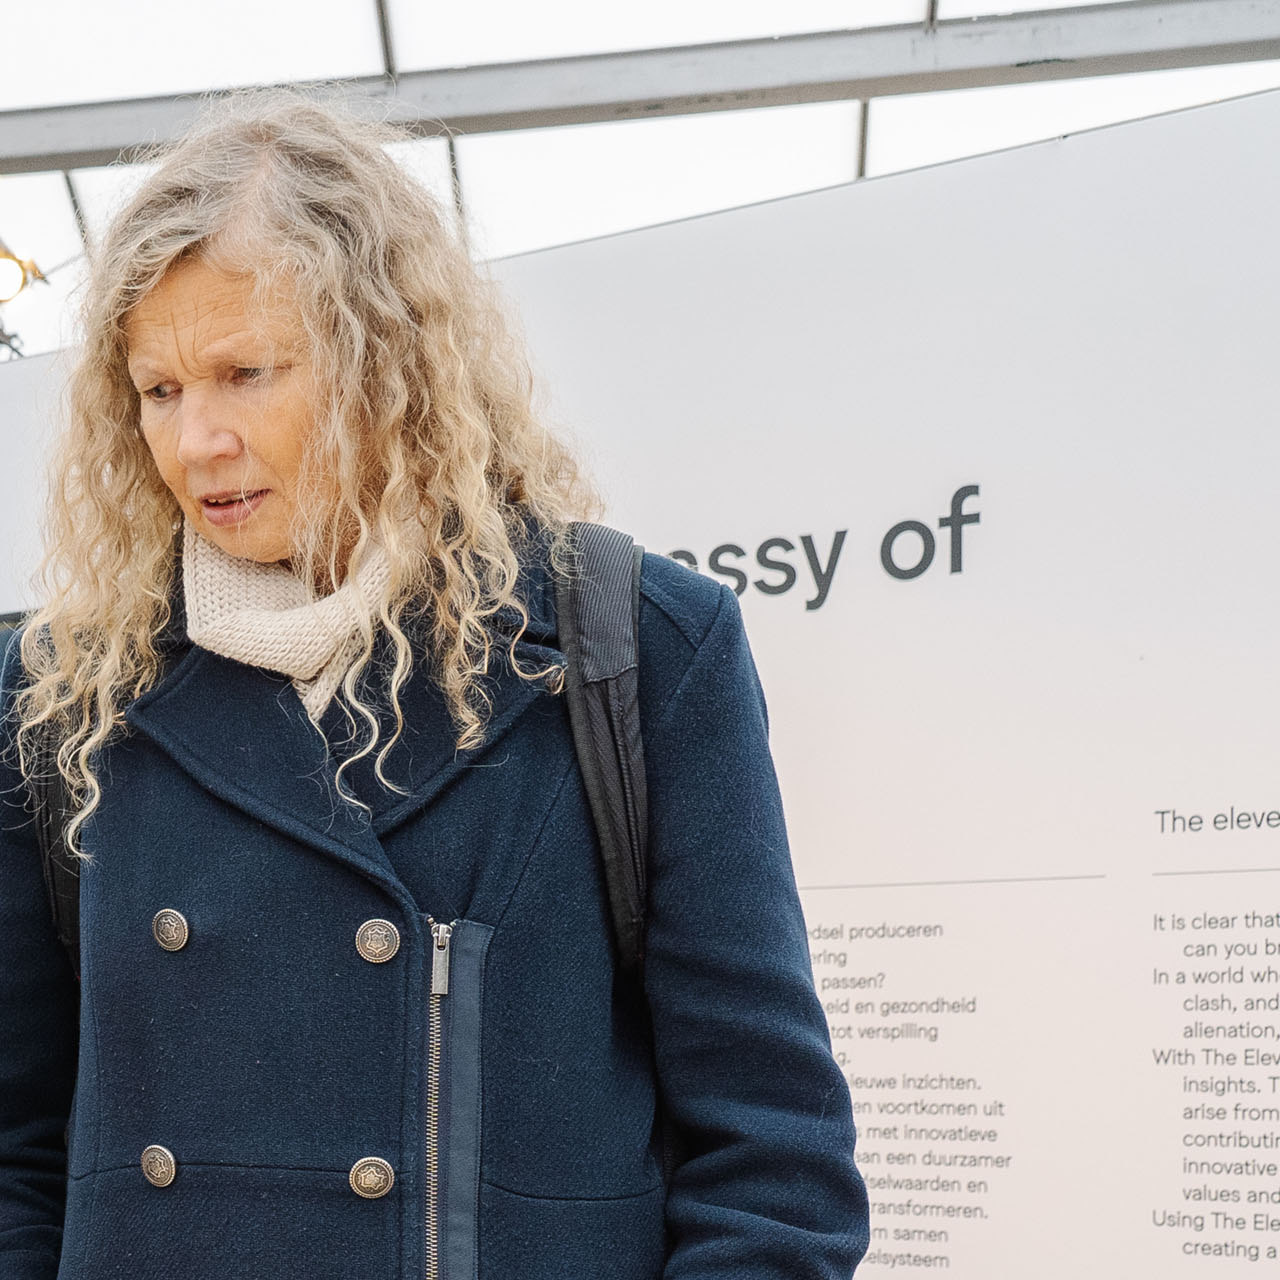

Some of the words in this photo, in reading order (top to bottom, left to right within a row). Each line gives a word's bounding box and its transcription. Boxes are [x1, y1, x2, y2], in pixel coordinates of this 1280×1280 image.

[880, 484, 981, 581] of
[1154, 810, 1204, 833] The
[1153, 914, 1165, 931] It
[1171, 914, 1186, 930] is
[1191, 912, 1238, 930] clear
[1244, 910, 1280, 929] that
[849, 923, 943, 941] produceren
[1183, 943, 1217, 957] can
[1224, 942, 1258, 960] you
[821, 973, 885, 991] passen?
[1153, 968, 1169, 984] In
[1175, 971, 1186, 984] a
[1192, 966, 1244, 984] world
[855, 1003, 875, 1014] en
[881, 998, 977, 1017] gezondheid
[1183, 994, 1237, 1014] clash,
[1244, 993, 1280, 1011] and
[858, 1023, 938, 1042] verspilling
[1151, 1048, 1195, 1066] With
[1202, 1048, 1237, 1066] The
[848, 1074, 897, 1090] ieuwe
[902, 1074, 981, 1090] inzichten.
[1183, 1076, 1261, 1097] insights.
[877, 1100, 977, 1116] voortkomen
[983, 1101, 1006, 1116] uit
[1183, 1103, 1227, 1121] arise
[1233, 1102, 1280, 1121] from
[867, 1126, 899, 1140] met
[904, 1124, 998, 1142] innovatieve
[886, 1152, 916, 1165] een
[922, 1150, 1012, 1168] duurzamer
[1183, 1157, 1278, 1177] innovative
[967, 1179, 988, 1193] en
[1182, 1184, 1241, 1203] values
[1152, 1210, 1205, 1232] Using
[1211, 1212, 1246, 1230] The
[893, 1227, 949, 1242] samen
[1182, 1239, 1259, 1261] creating
[1267, 1246, 1277, 1259] a
